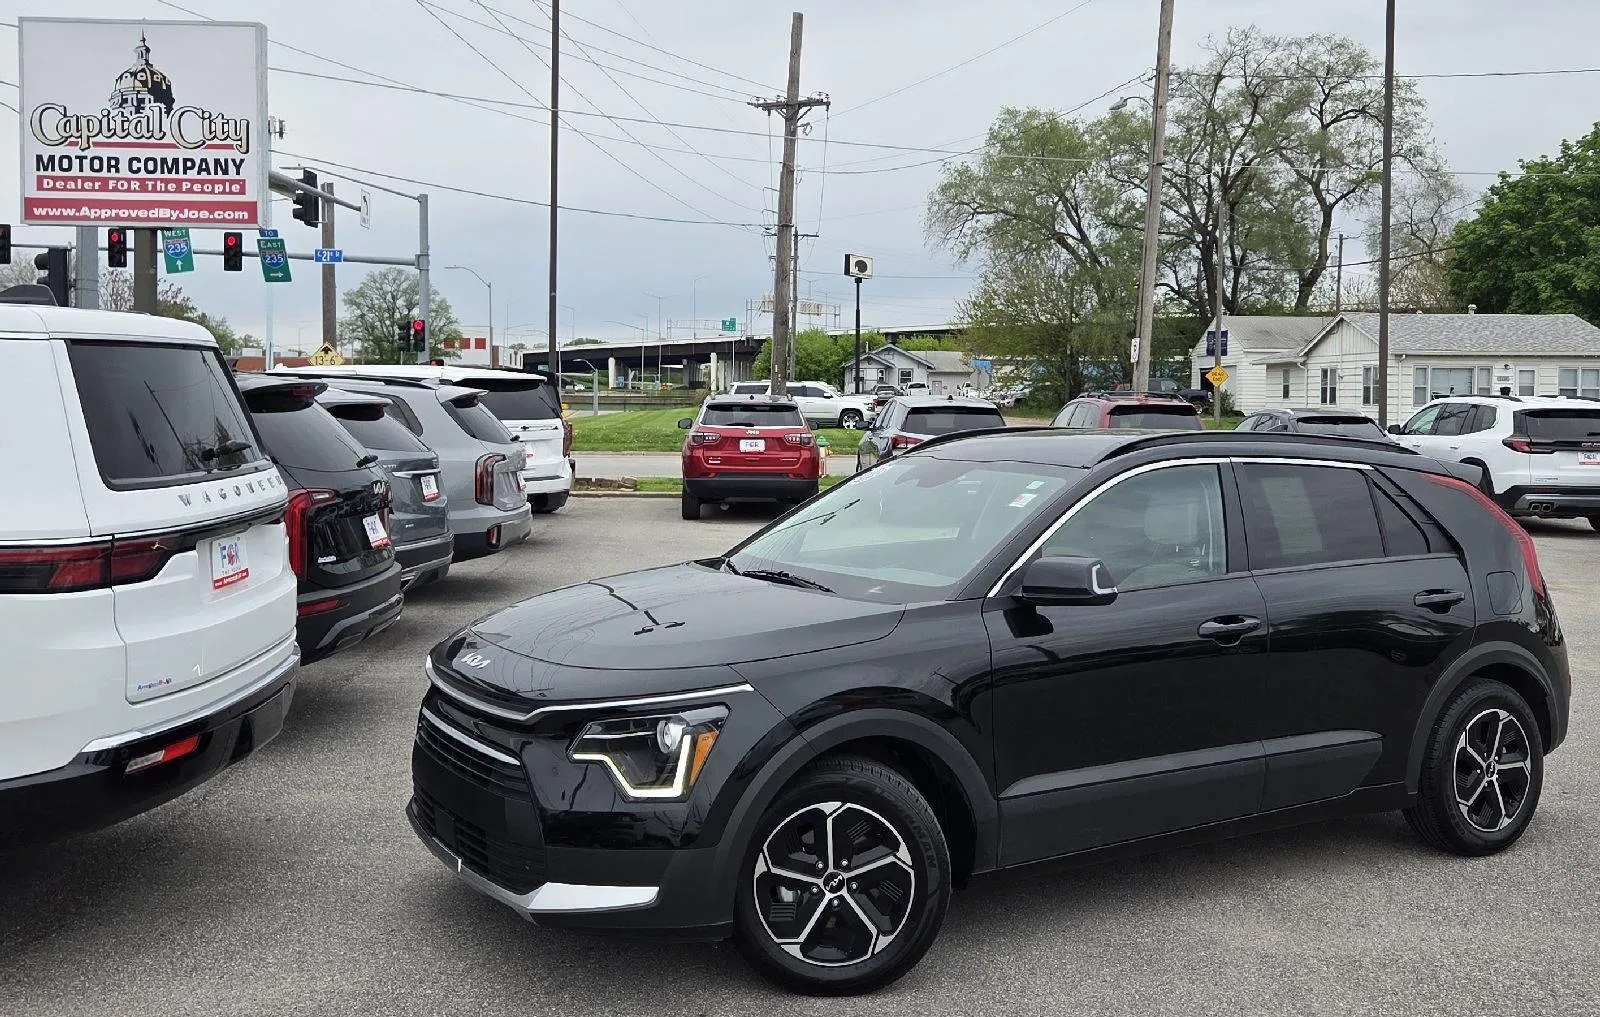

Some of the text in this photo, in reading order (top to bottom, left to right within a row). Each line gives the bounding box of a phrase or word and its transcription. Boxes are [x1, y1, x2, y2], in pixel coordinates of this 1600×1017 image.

[30, 103, 250, 154] Capital City
[35, 154, 245, 176] MOTOR COMPANY
[43, 178, 240, 194] Dealer FOR The People
[33, 206, 249, 220] www.ApprovedByJoe.com
[163, 229, 187, 238] WEST
[168, 243, 188, 254] 235
[265, 254, 284, 263] 235
